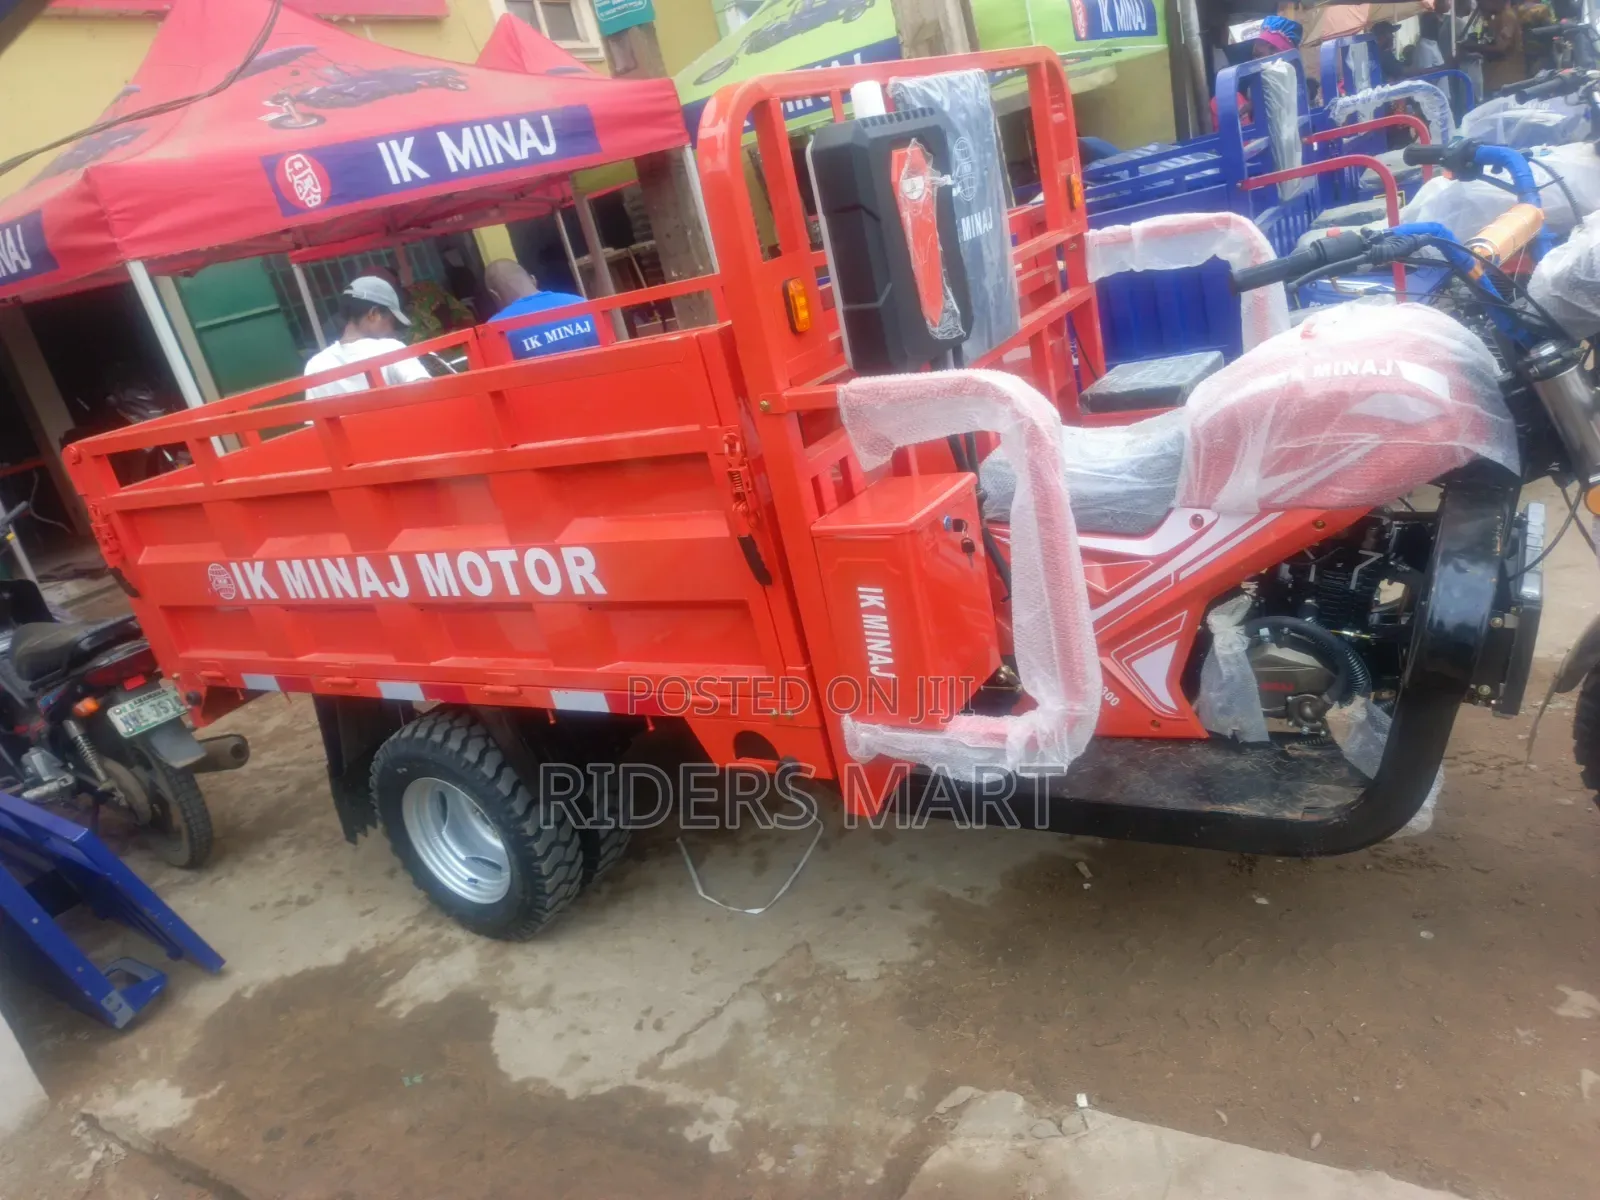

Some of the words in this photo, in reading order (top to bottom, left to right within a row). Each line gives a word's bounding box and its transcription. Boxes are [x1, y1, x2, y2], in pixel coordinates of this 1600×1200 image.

[377, 136, 430, 185] IK
[436, 115, 557, 173] MINAJ
[961, 207, 993, 242] MINAJ
[521, 335, 543, 352] IK
[544, 320, 591, 344] MINAJ
[1313, 359, 1394, 378] MINAJ
[230, 561, 279, 600] IK
[276, 555, 410, 600] MINAJ
[416, 546, 608, 598] MOTOR
[857, 586, 886, 610] IK
[862, 614, 896, 678] MINAJ
